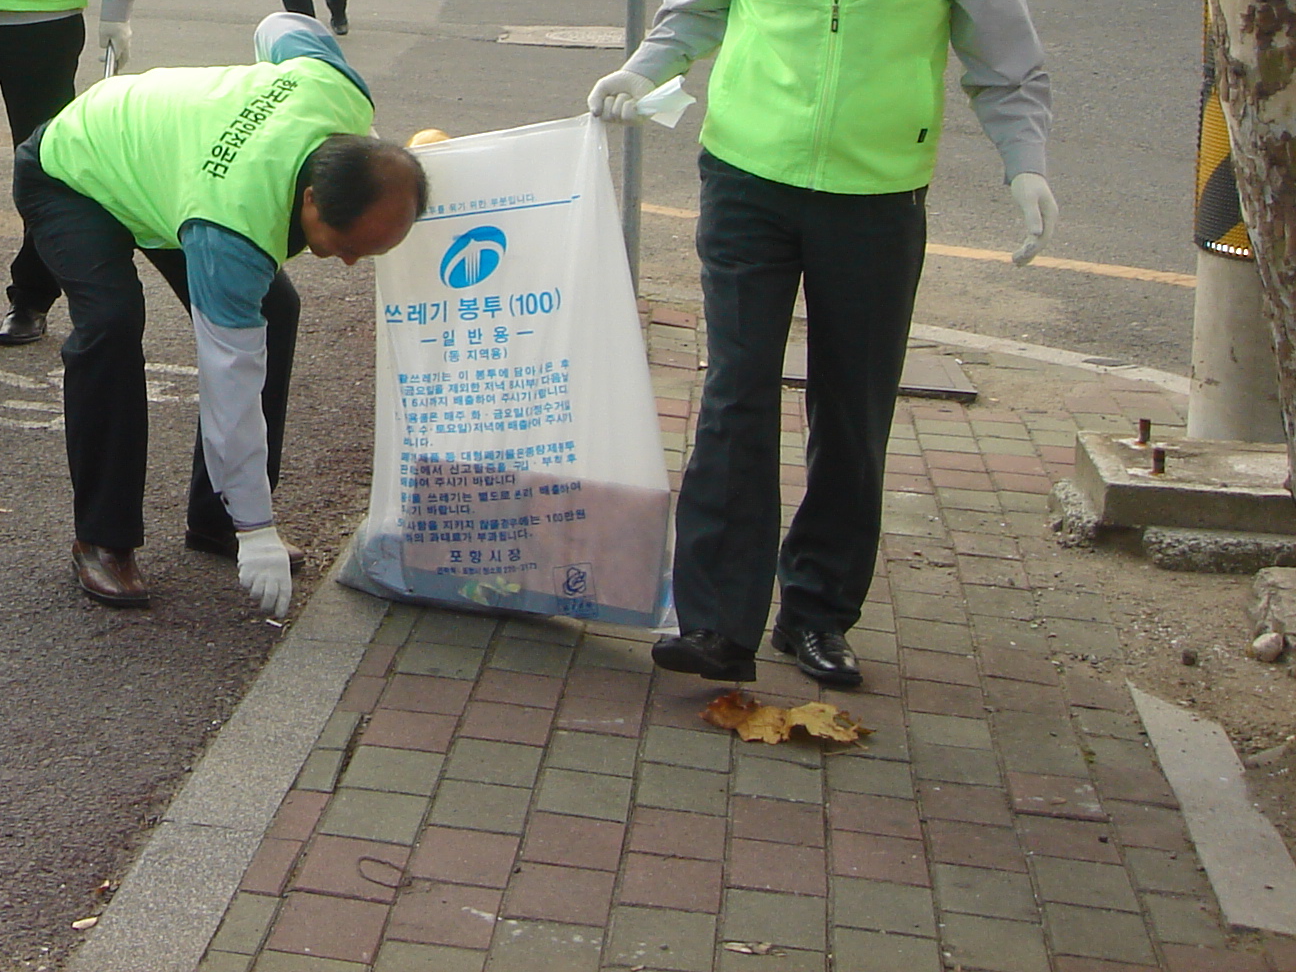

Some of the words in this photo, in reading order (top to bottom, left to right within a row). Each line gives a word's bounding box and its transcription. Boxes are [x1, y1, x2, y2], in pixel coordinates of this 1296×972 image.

[202, 73, 298, 180] 한국산업안전공단
[385, 301, 448, 325] 쓰레기
[457, 296, 503, 321] 봉투
[509, 289, 561, 317] (100)
[467, 347, 508, 361] 지역용)
[448, 382, 480, 394] 제외한
[454, 394, 496, 407] 배출하여
[501, 391, 532, 404] 주시기
[435, 475, 468, 487] 주시기
[427, 492, 473, 504] 쓰레기는
[538, 481, 582, 495] 배출하여
[426, 504, 475, 516] 바랍니다.
[443, 519, 475, 531] 지키지
